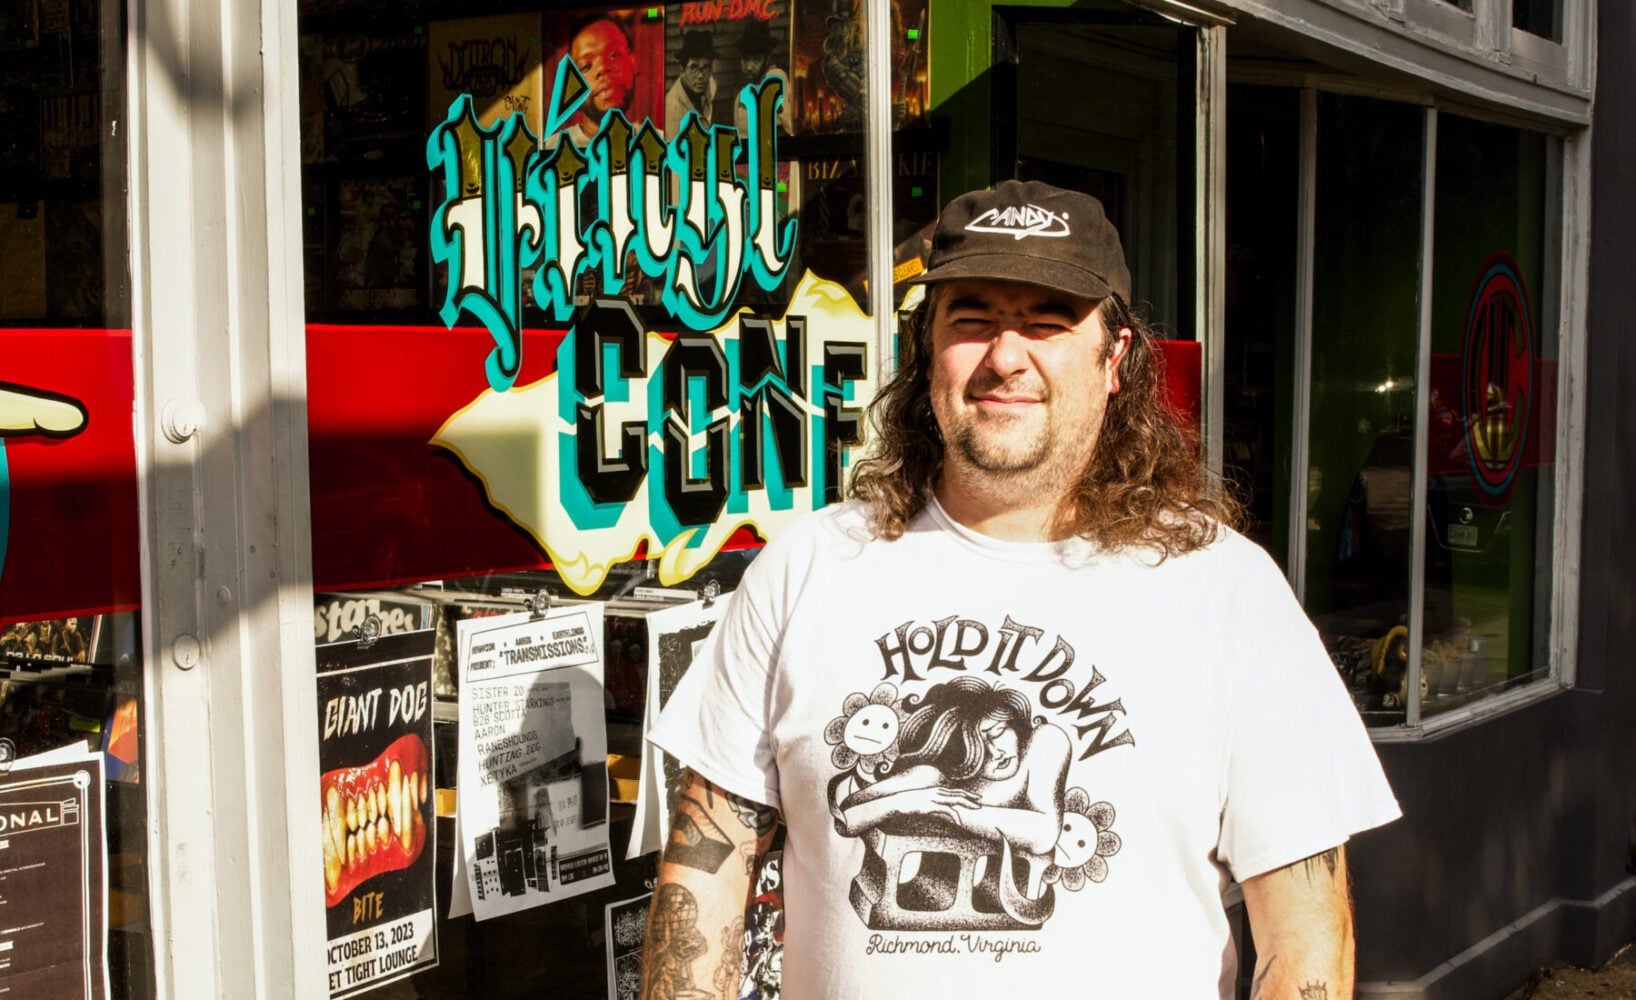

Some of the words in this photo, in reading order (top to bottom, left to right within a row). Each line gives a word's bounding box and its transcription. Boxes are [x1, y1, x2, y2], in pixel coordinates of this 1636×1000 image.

[557, 298, 916, 538] CONF
[472, 686, 508, 700] SISTER
[874, 615, 989, 684] HOLD
[984, 614, 1045, 676] IT
[1019, 635, 1136, 761] DOWN
[323, 687, 383, 741] GIANT
[388, 681, 428, 728] DOG
[479, 749, 522, 772] HUNTING
[352, 892, 384, 925] BITE
[327, 936, 372, 965] CTOBER
[374, 931, 389, 950] 13,
[391, 921, 414, 944] 2023
[960, 934, 1041, 962] Virginia
[329, 970, 343, 991] ET
[345, 959, 377, 985] TIGHT
[379, 945, 418, 973] LOUNGE
